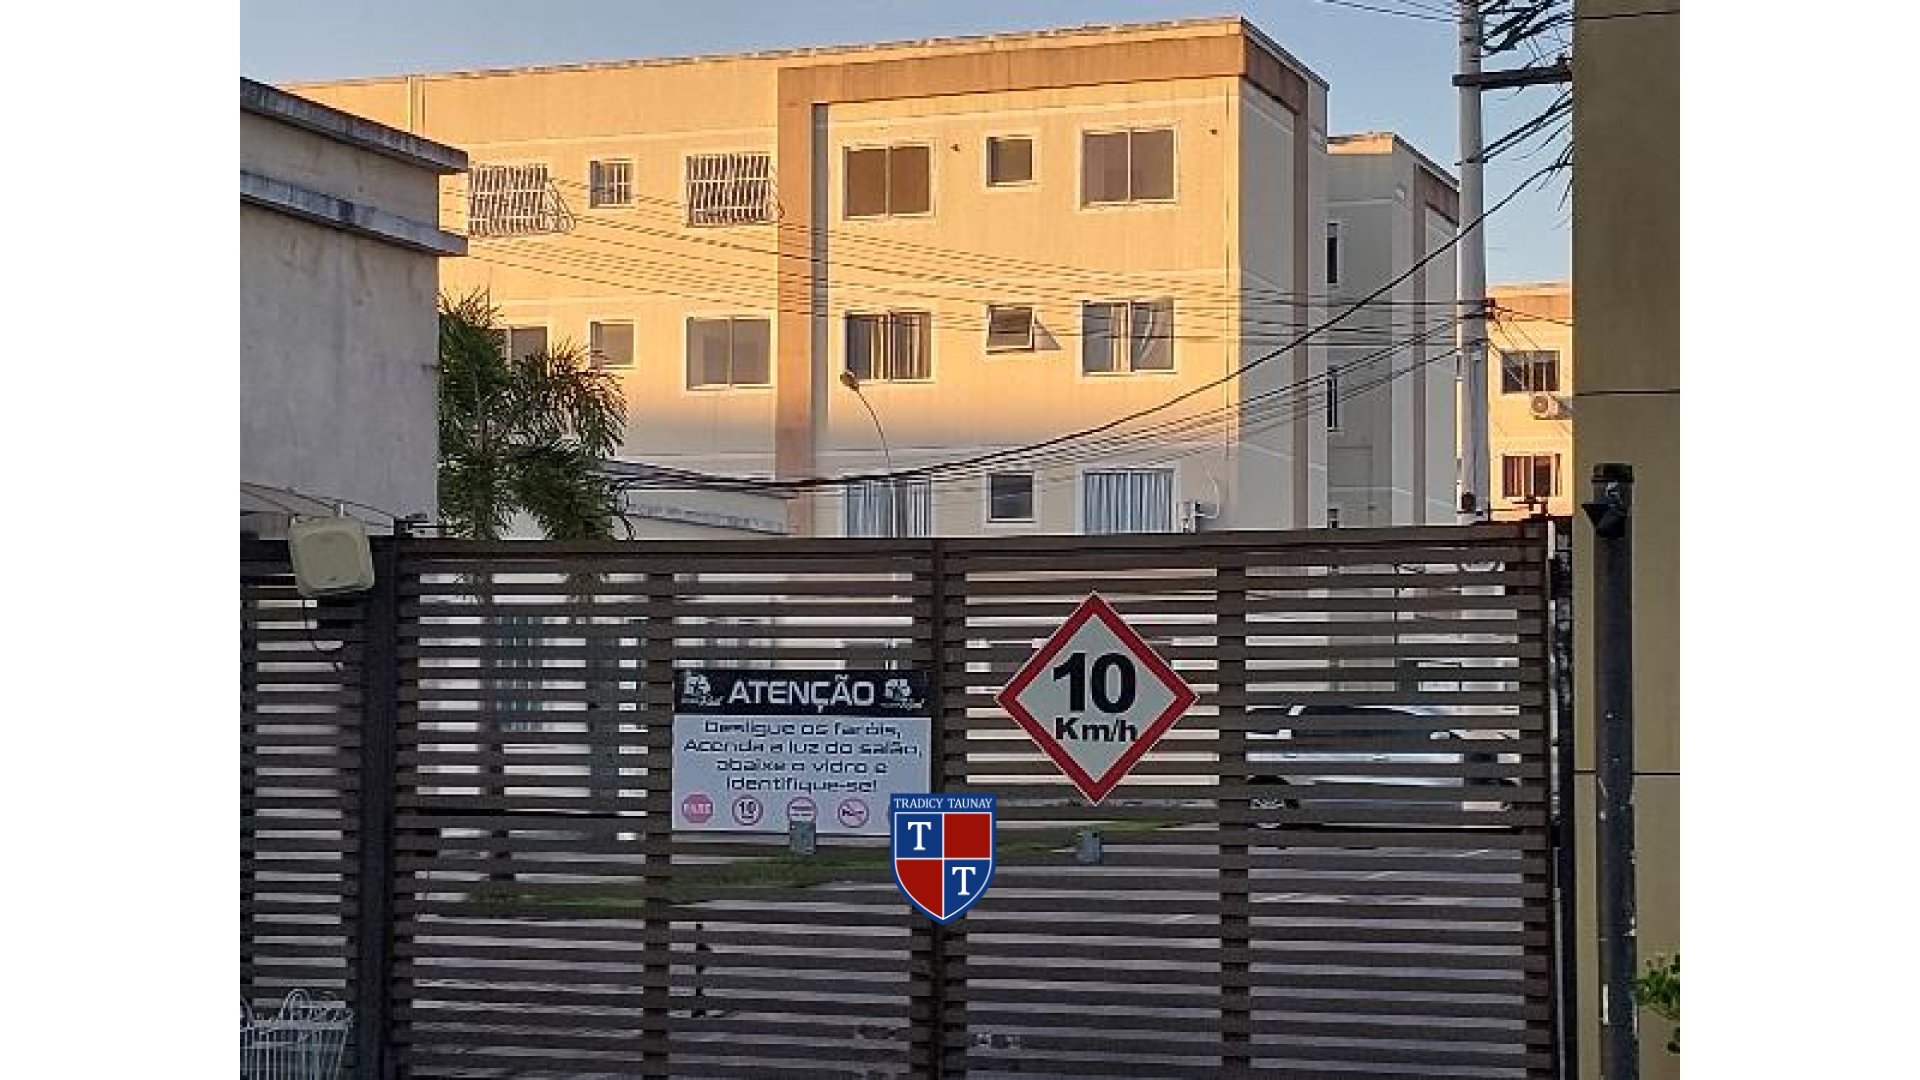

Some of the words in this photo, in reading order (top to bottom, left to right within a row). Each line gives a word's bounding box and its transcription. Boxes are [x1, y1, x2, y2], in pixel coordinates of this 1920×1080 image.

[727, 673, 875, 713] ATENÇÃO
[1053, 652, 1136, 714] 10
[704, 720, 796, 738] Desligue
[801, 724, 829, 735] os
[834, 721, 901, 739] faróis,
[1055, 717, 1138, 742] Km/h
[683, 738, 764, 753] Acenda
[788, 740, 820, 754] luz
[825, 740, 853, 755] do
[858, 741, 923, 758] salão,
[716, 757, 787, 772] abaixe
[812, 759, 868, 774] vidro
[874, 762, 888, 774] e
